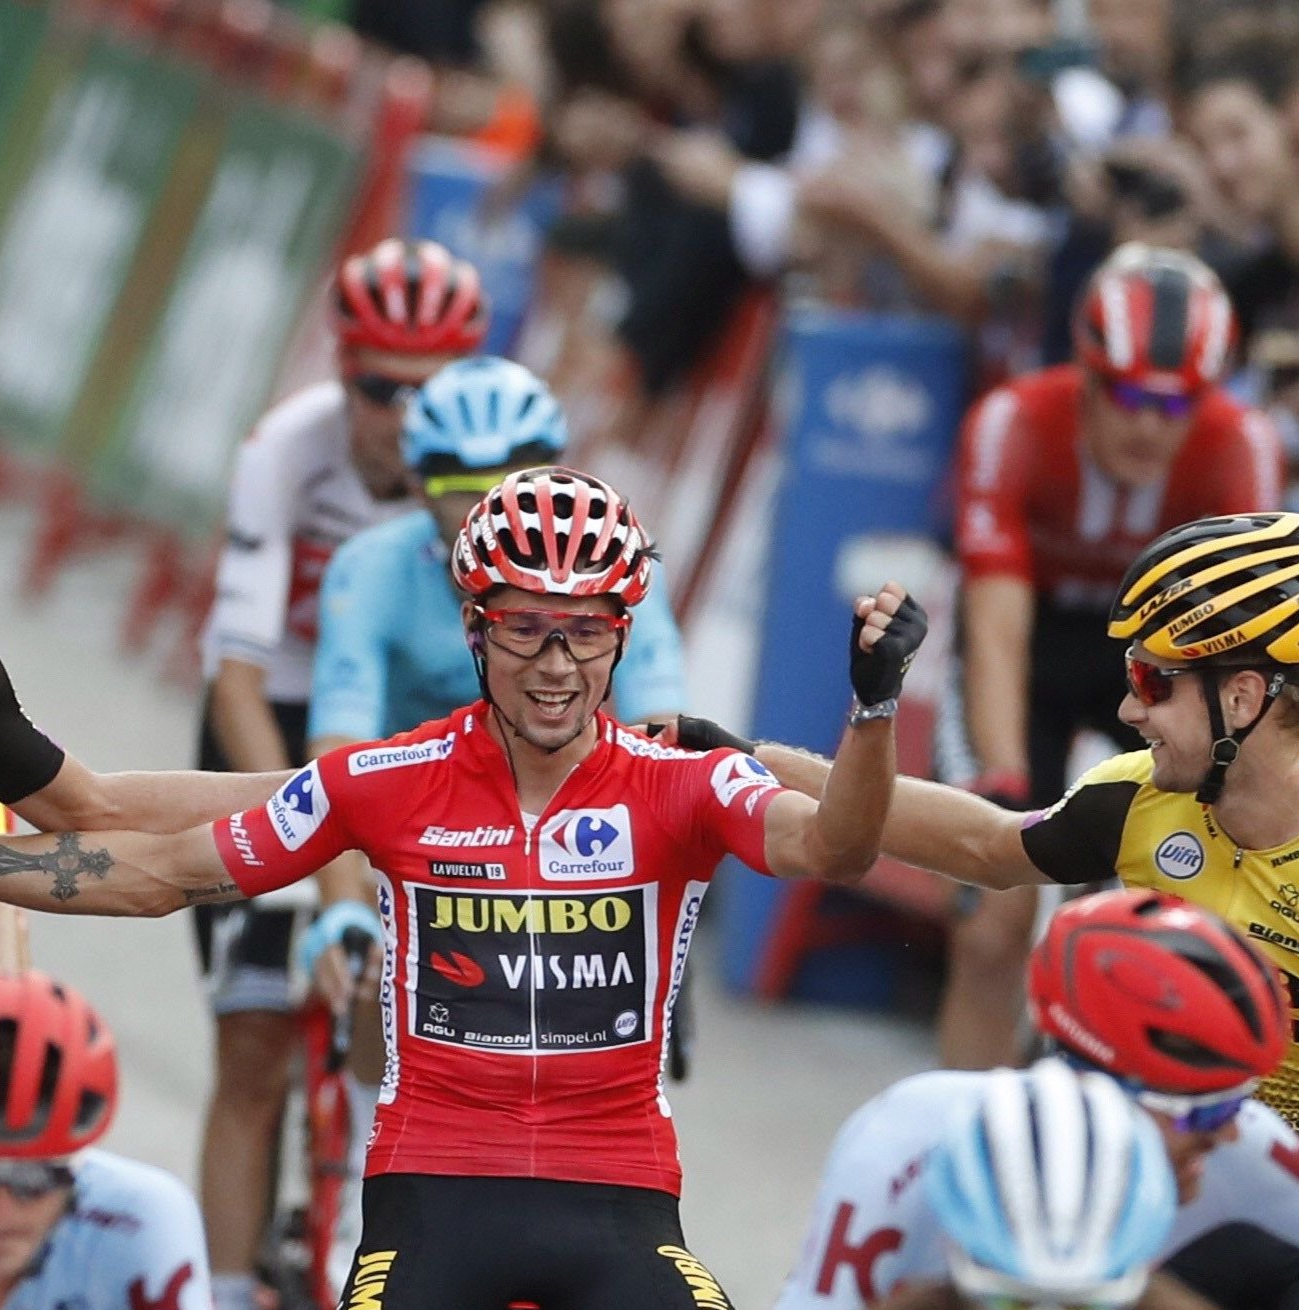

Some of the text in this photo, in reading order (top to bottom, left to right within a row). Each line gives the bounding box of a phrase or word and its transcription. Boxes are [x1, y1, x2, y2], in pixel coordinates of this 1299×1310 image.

[1139, 578, 1194, 621] LAZER
[1167, 603, 1215, 638] JUMBO
[1202, 631, 1247, 654] VISMA
[357, 747, 432, 769] Carrefour
[418, 825, 515, 847] Santini
[1159, 843, 1201, 868] Vifit
[549, 860, 625, 874] Carrefour
[429, 896, 632, 934] JUMBO
[498, 952, 634, 989] VISMA
[423, 1023, 455, 1037] AGU
[464, 1032, 530, 1044] Bianchi
[540, 1030, 607, 1044] simpel.nl
